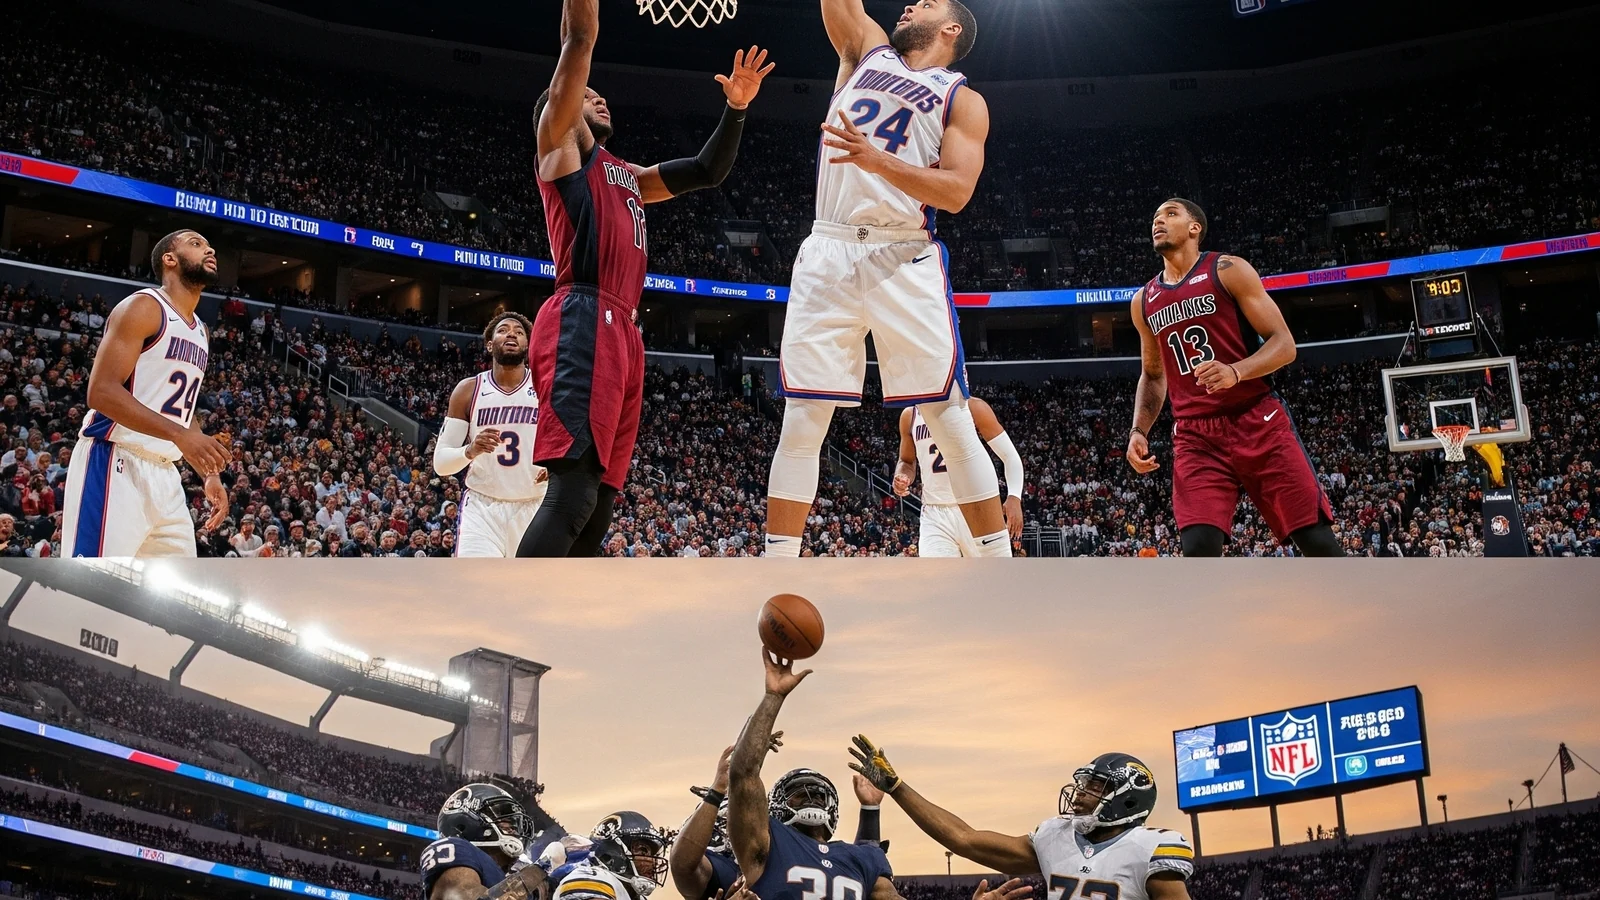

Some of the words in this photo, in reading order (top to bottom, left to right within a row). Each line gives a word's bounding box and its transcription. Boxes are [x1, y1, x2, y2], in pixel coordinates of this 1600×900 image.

[849, 97, 914, 155] 24
[1167, 325, 1215, 376] 13
[160, 370, 201, 423] 24
[497, 431, 520, 467] 3
[1269, 742, 1315, 777] NFL
